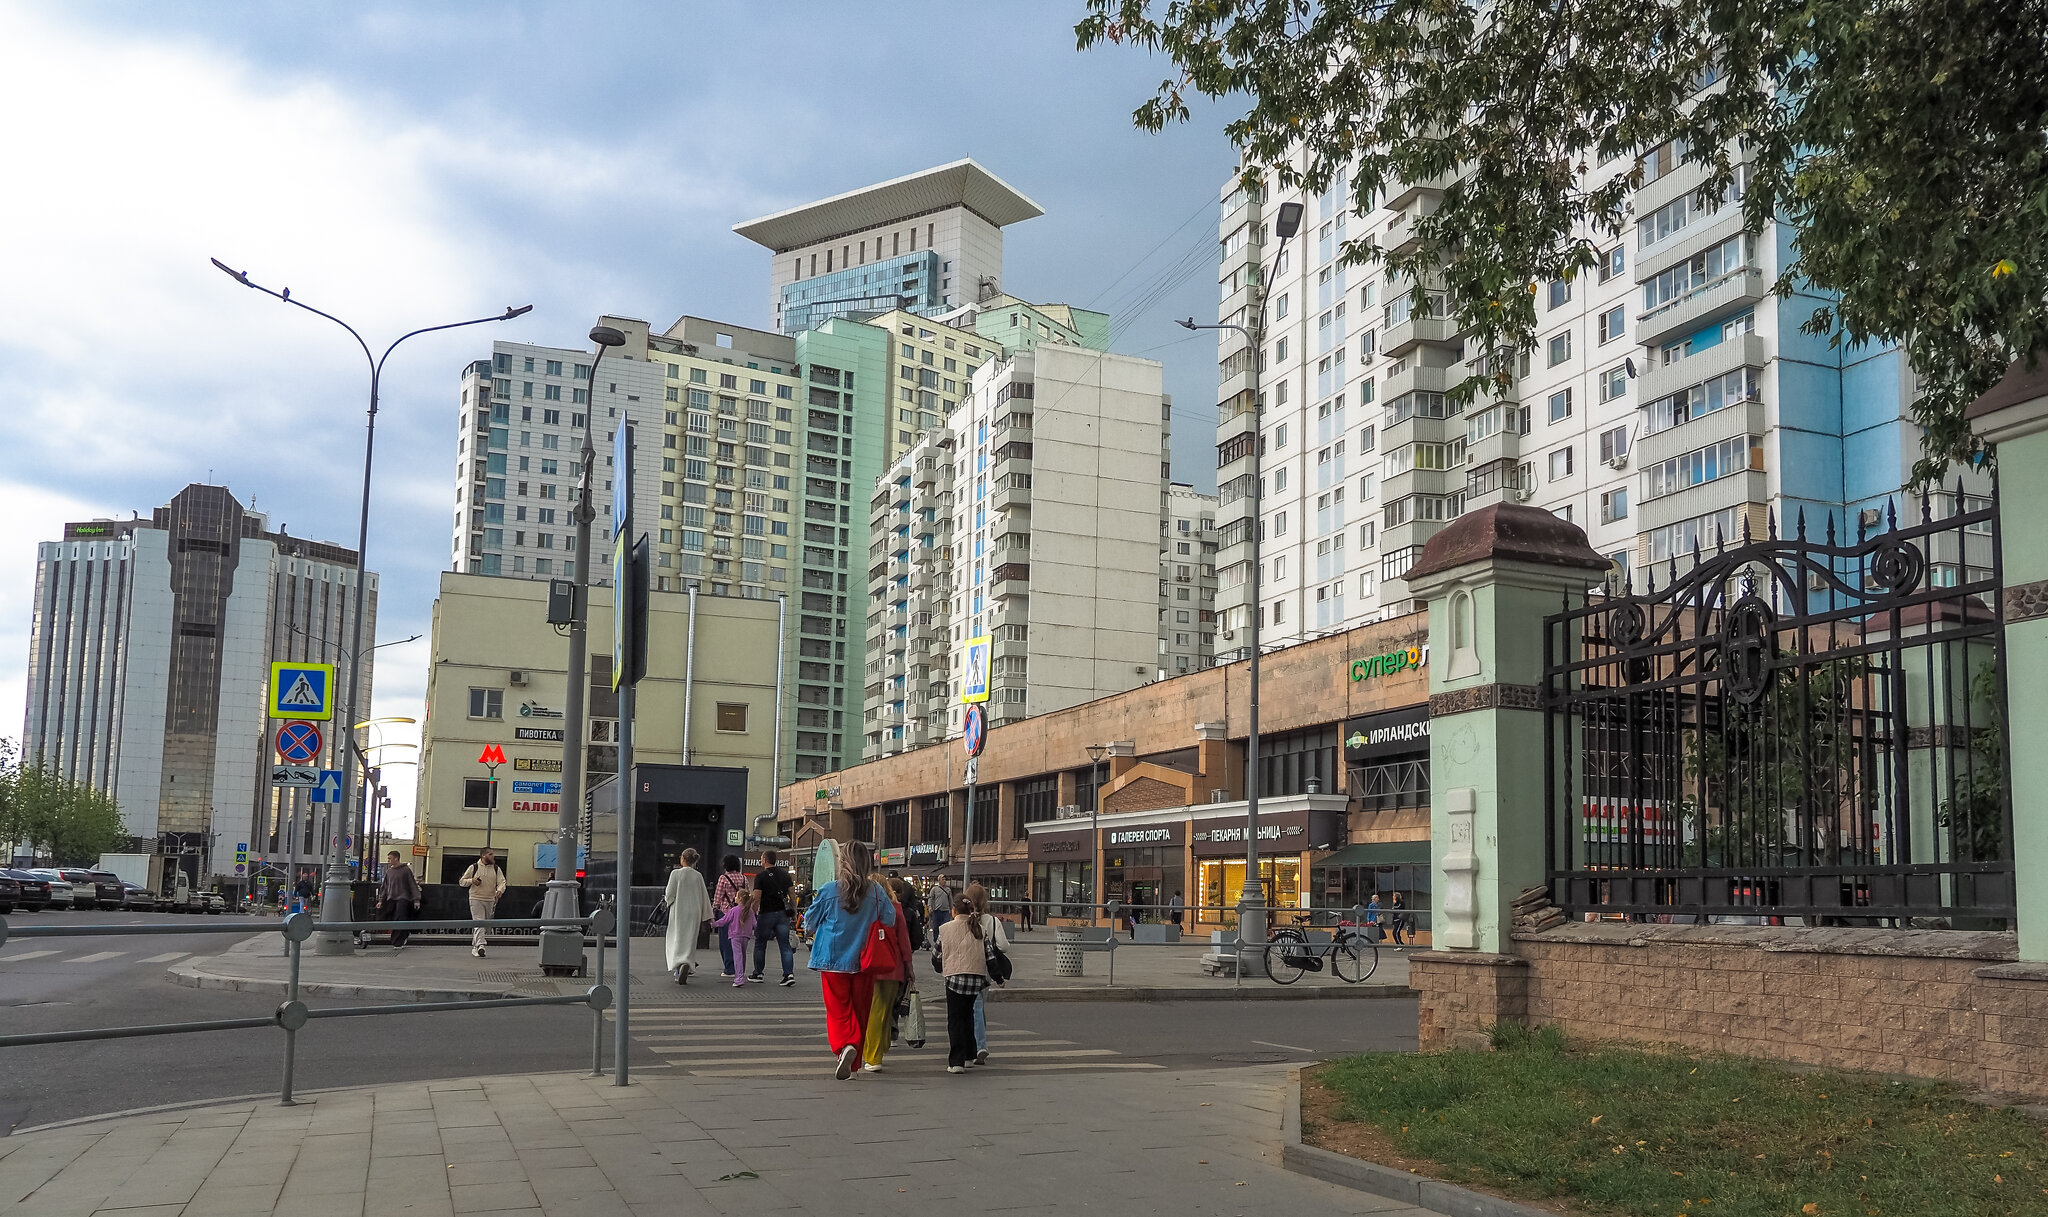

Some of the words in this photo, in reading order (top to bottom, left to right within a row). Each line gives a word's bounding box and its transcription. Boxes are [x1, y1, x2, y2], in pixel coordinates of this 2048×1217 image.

[519, 729, 557, 740] ПИВОТЕКА
[513, 801, 559, 812] САЛОН
[1118, 830, 1145, 843] ГАЛЕРЕЯ
[1145, 828, 1171, 842] СПОРТА
[1211, 828, 1241, 842] ПЕКАРНЯ
[1243, 825, 1281, 841] МЬНИЦА
